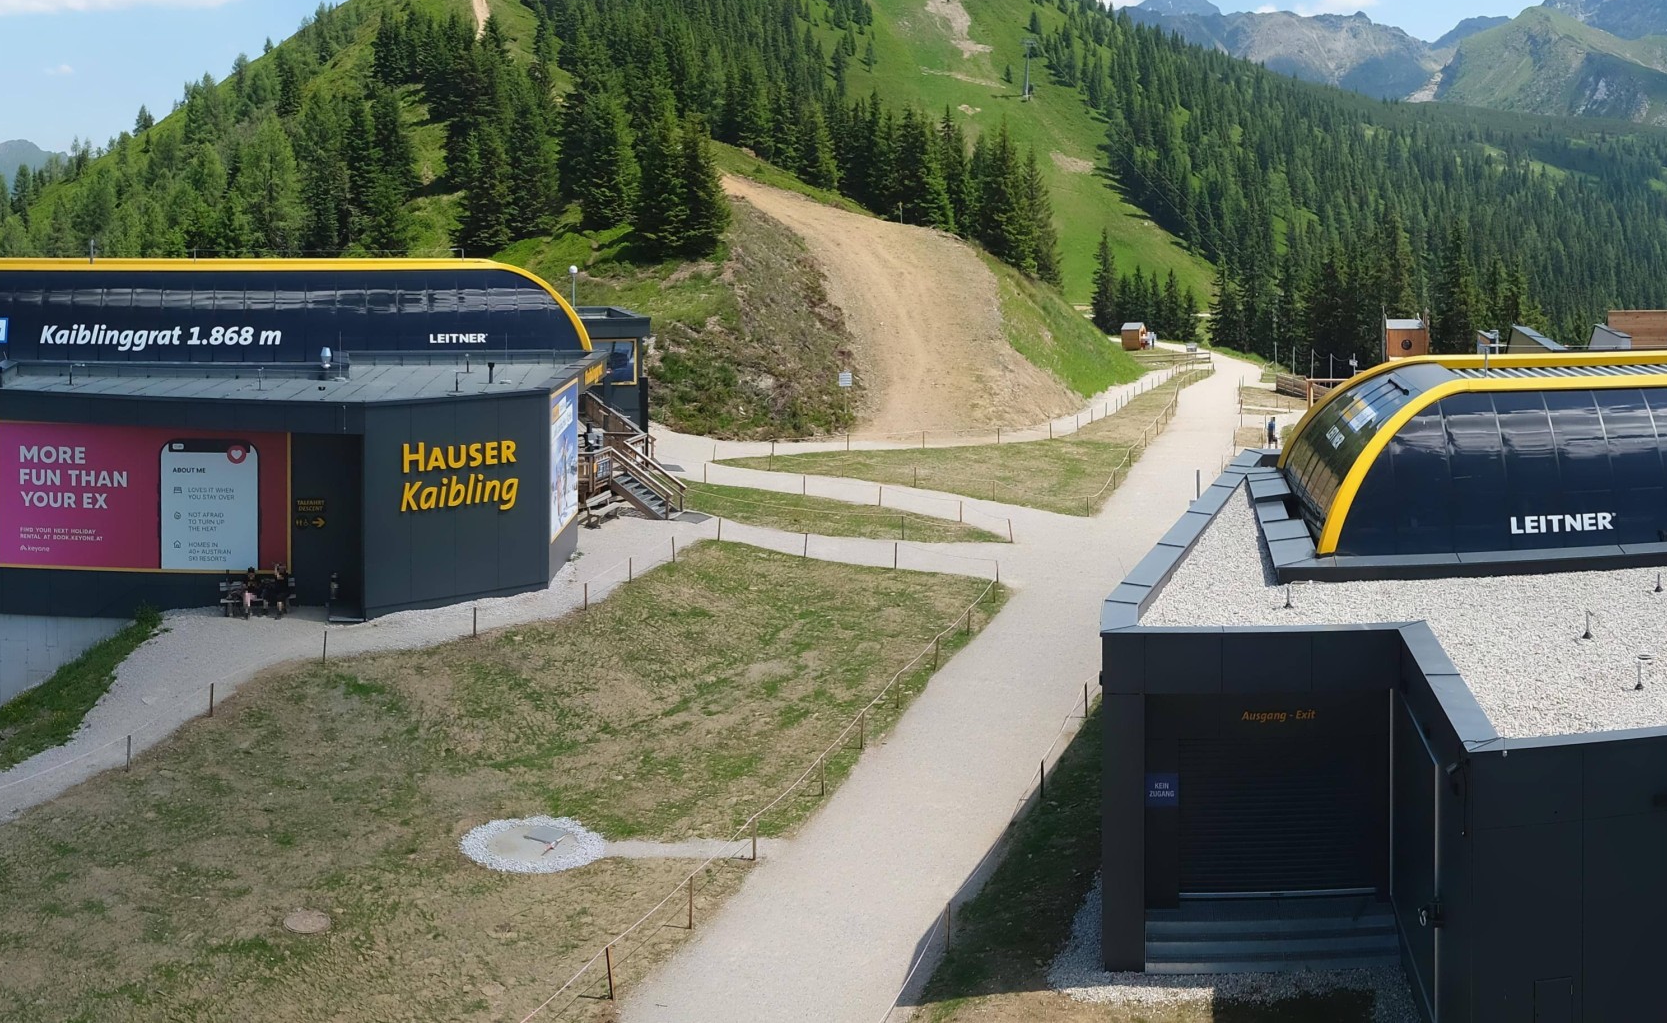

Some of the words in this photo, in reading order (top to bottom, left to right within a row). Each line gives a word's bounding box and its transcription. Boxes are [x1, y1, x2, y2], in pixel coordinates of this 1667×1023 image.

[40, 323, 182, 351] Kaiblinggrat
[187, 326, 254, 345] 1.868
[259, 330, 282, 344] m
[429, 333, 487, 344] LEITNER
[19, 445, 86, 464] MORE
[403, 440, 517, 474] HAUSER
[19, 468, 61, 485] FUN
[68, 470, 128, 488] THAN
[20, 491, 76, 508] YOUR
[82, 493, 108, 509] EX
[400, 473, 520, 512] Kaibling
[1510, 512, 1615, 534] LEITNER
[1241, 710, 1287, 723] Ausgang
[1295, 709, 1316, 720] Exit
[1154, 782, 1170, 790] KEIN
